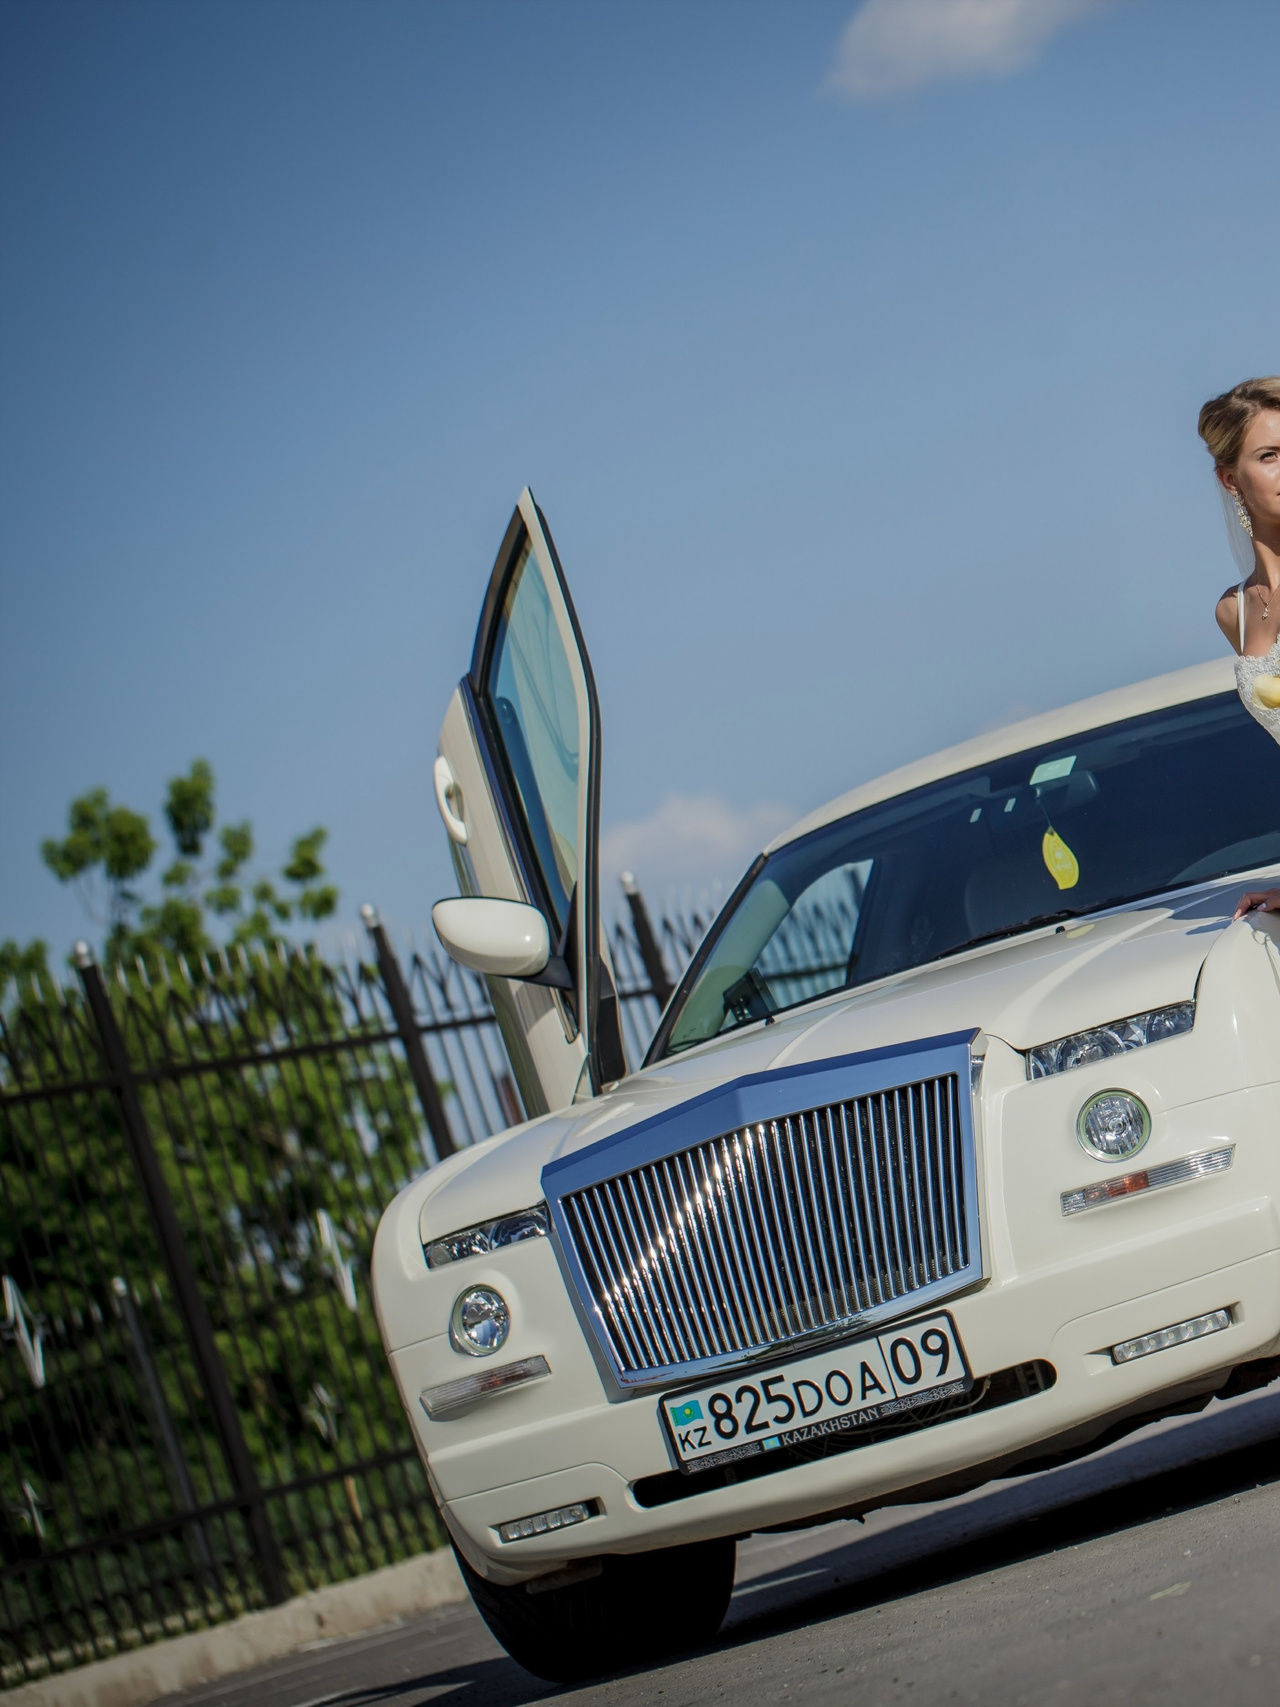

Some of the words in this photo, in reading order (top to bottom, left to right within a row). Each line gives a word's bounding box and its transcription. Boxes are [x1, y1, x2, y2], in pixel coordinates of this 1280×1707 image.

[889, 1327, 951, 1385] 09
[677, 1425, 712, 1452] KZ
[781, 1406, 881, 1446] KAZAKHSTAN
